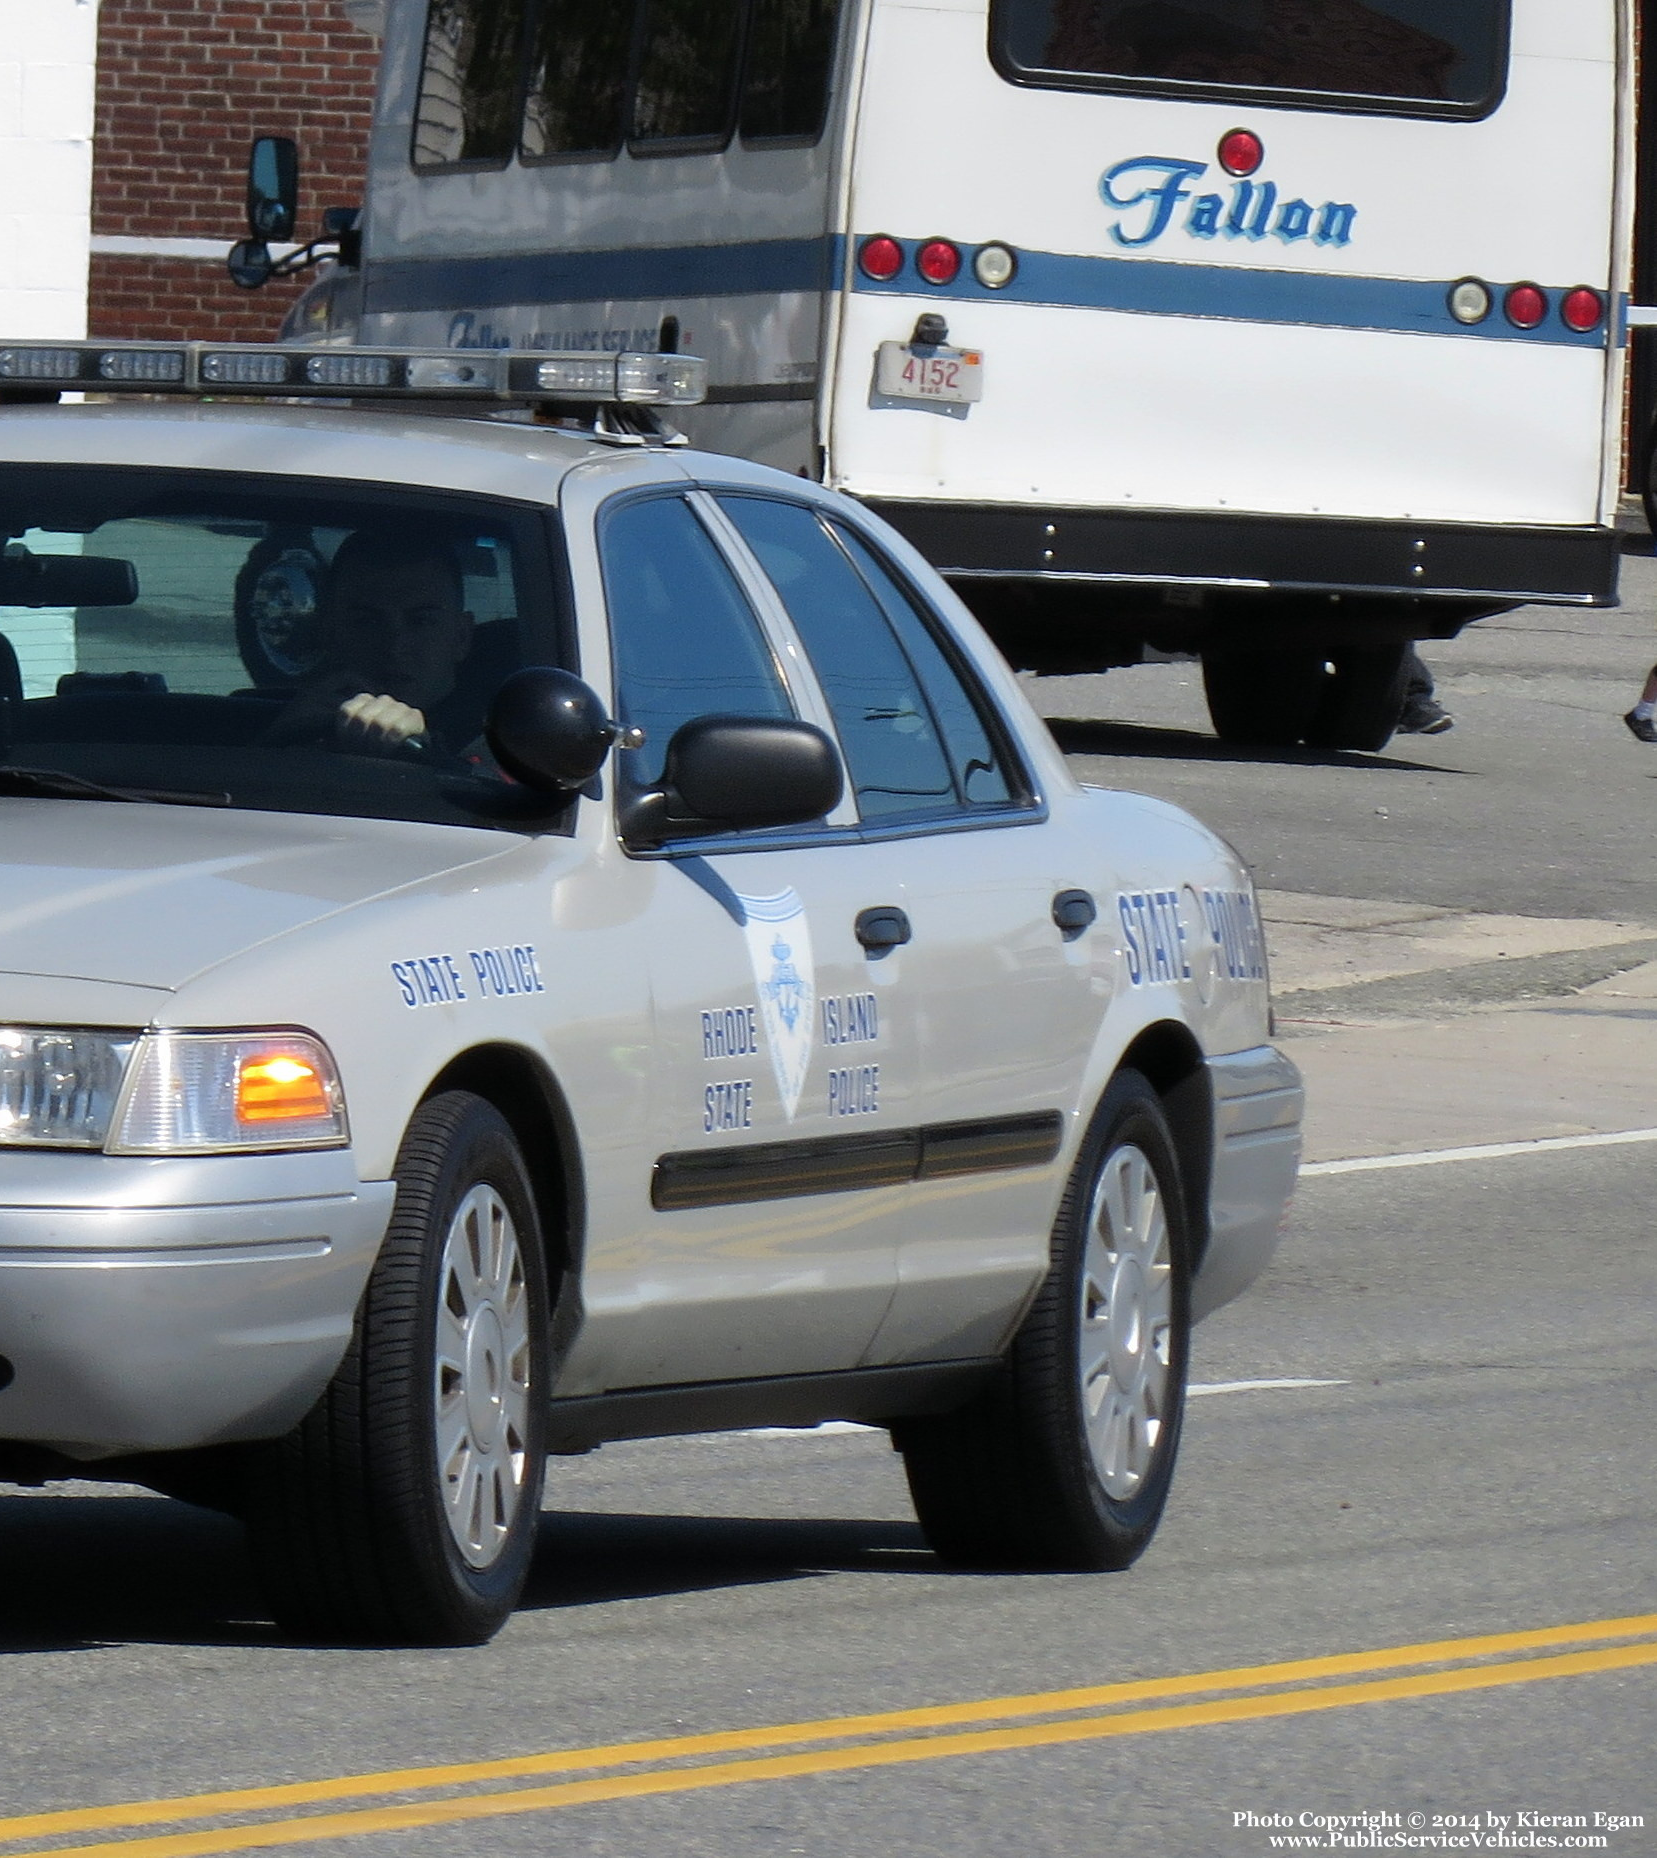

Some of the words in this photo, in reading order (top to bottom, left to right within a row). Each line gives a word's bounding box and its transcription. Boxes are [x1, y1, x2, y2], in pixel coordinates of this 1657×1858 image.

[1098, 156, 1358, 248] Fallon
[902, 359, 960, 388] 4152
[1118, 890, 1192, 985] STATE
[391, 954, 467, 1007] STATE
[468, 945, 545, 998] POLICE
[702, 1005, 758, 1060] RHODE
[821, 992, 878, 1047] ISLAND
[704, 1079, 753, 1134] STATE
[828, 1064, 880, 1118] POLICE
